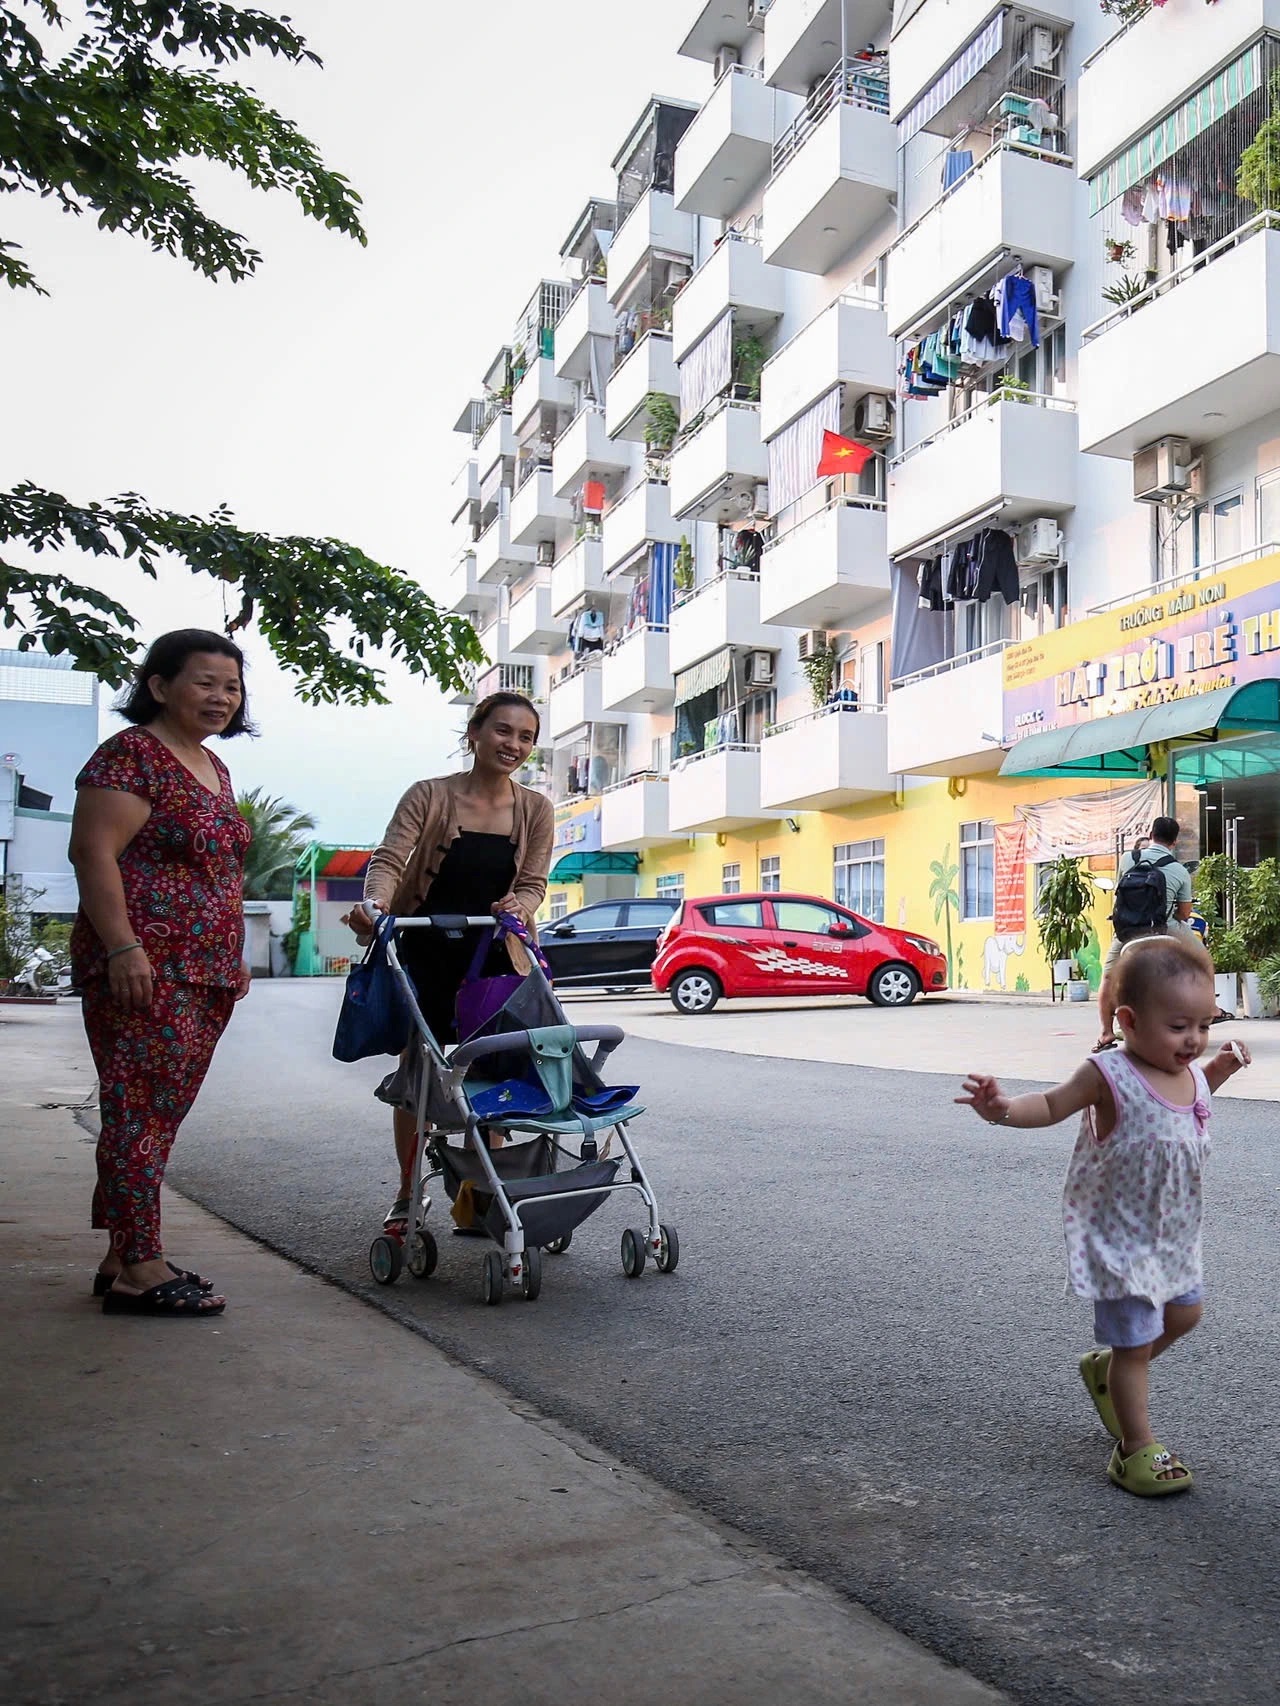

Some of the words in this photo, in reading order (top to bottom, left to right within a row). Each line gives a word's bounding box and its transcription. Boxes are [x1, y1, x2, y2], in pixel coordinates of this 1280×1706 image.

[1199, 583, 1227, 607] NON
[1111, 637, 1174, 690] TRỜI
[1178, 611, 1238, 673] TRẺ
